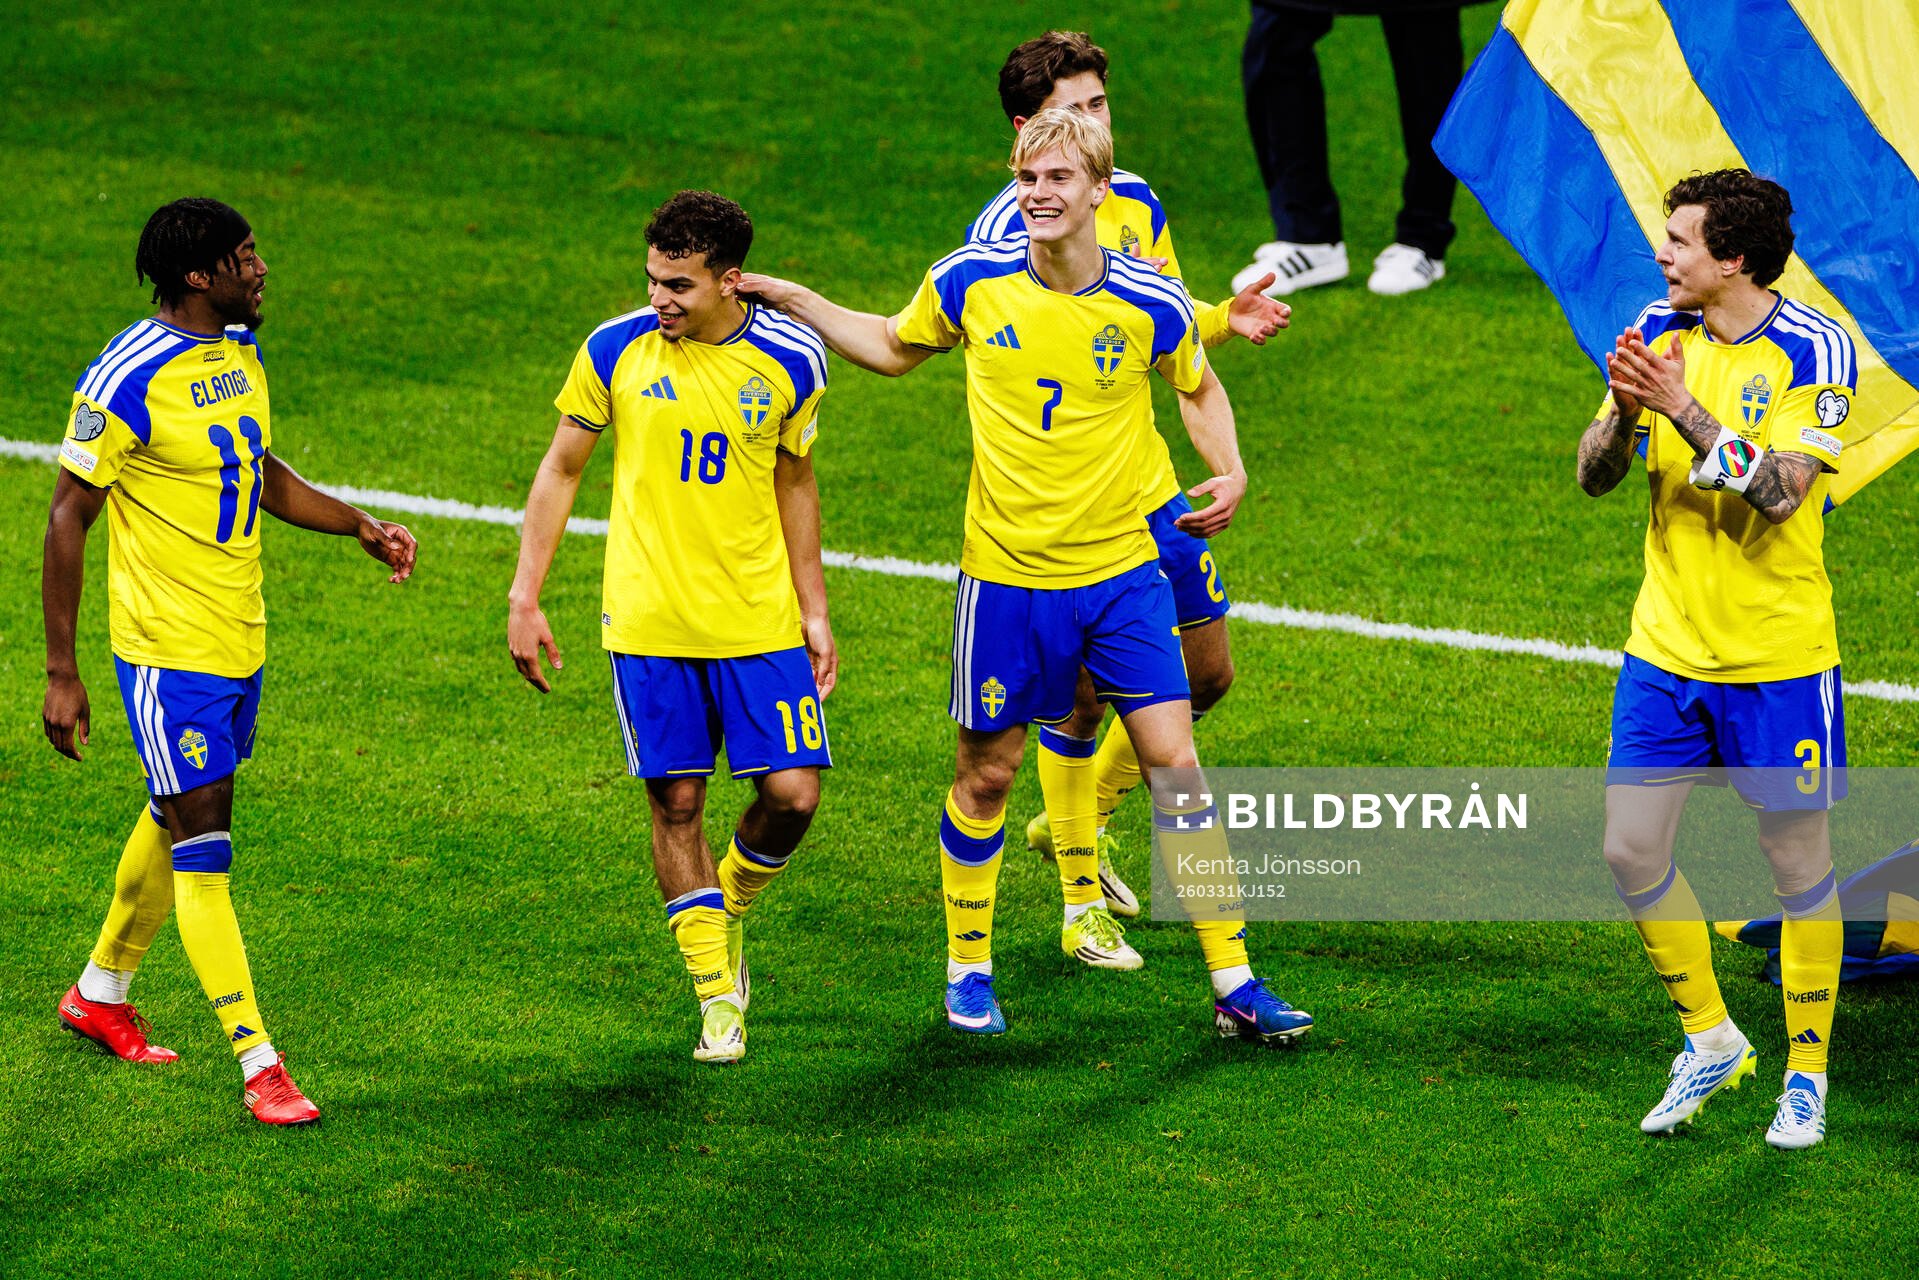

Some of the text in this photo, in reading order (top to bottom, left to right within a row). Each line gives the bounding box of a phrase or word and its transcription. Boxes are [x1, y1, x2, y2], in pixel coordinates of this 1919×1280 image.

[190, 369, 252, 408] ELANGA
[1037, 378, 1062, 431] 7
[208, 415, 264, 543] 11
[680, 428, 729, 485] 18
[1199, 550, 1225, 603] 2
[775, 695, 823, 754] 18
[1794, 739, 1821, 795] 3
[1786, 988, 1829, 1003] SVERIGE
